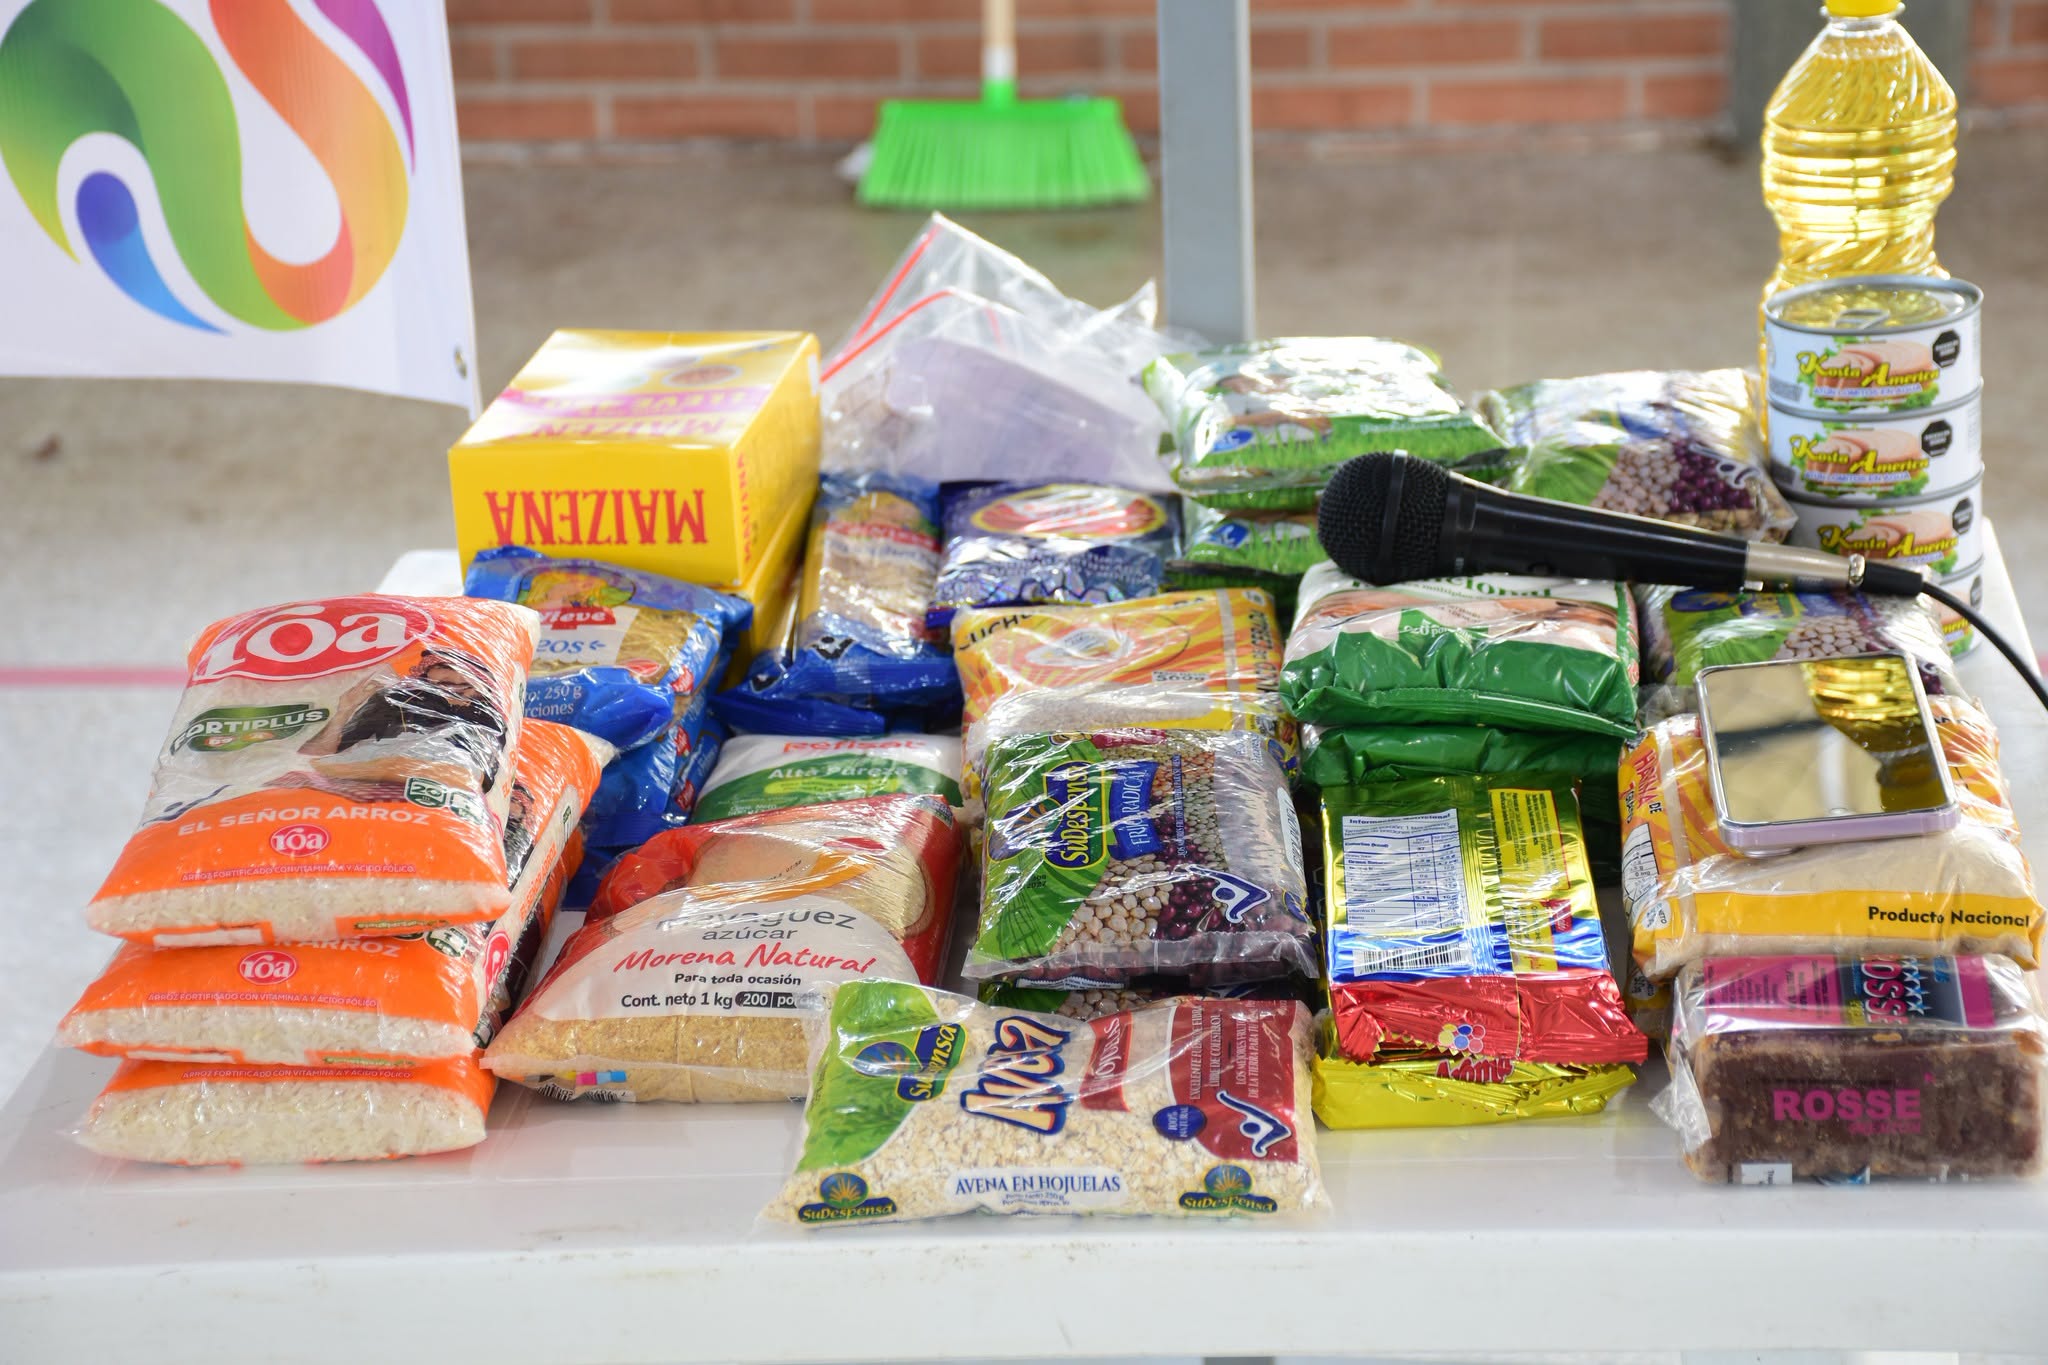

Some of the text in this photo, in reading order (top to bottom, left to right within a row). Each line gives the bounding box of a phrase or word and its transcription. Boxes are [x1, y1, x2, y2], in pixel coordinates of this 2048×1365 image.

[1797, 350, 1861, 379] Kosta
[1789, 435, 1849, 464] Kosta
[484, 489, 709, 546] MAIZENA
[544, 686, 570, 699] 250
[573, 687, 582, 700] g
[170, 707, 330, 755] FORTIPLUS
[768, 766, 908, 779] Alta Pureza
[178, 805, 432, 837] EL SEÑOR ARROZ
[182, 872, 213, 882] ARROZ
[213, 866, 273, 879] FORTIFICADO
[273, 865, 294, 873] CON
[295, 864, 339, 873] VITAMINA
[1867, 905, 2030, 928] Producto Nacional
[701, 926, 798, 941] azúcar
[613, 941, 878, 975] Morena Natural
[674, 972, 802, 986] Para toda ocasión
[148, 993, 179, 1002] ARROZ
[180, 992, 239, 1002] FORTIFICADO
[239, 993, 258, 1001] CON
[259, 993, 300, 1003] VITAMINA
[621, 993, 661, 1008] Cont.
[665, 994, 697, 1008] neto
[700, 993, 710, 1008] 1
[713, 993, 734, 1011] kg
[742, 993, 769, 1006] 200
[1209, 1014, 1222, 1087] LIBRE DE COLESTEROL
[1247, 1033, 1259, 1052] PARA
[1236, 1040, 1249, 1071] MEJORES
[1247, 1052, 1259, 1077] TIERRA
[183, 1070, 213, 1079] ARROZ
[213, 1069, 273, 1079] FORTIFICADO
[273, 1069, 292, 1078] CON
[292, 1069, 335, 1078] VITAMINA
[1190, 1058, 1202, 1100] EXCELENTE
[1235, 1071, 1247, 1085] LOS
[1247, 1077, 1259, 1088] LA
[1247, 1088, 1259, 1099] DE
[1773, 1089, 1922, 1121] ROSSE
[1167, 1110, 1179, 1131] 100%
[1179, 1106, 1190, 1138] NATURAL
[956, 1175, 1122, 1195] AVENA EN HOJUELAS
[801, 1203, 893, 1221] SuDespensa
[1184, 1195, 1276, 1213] SuDespensa
